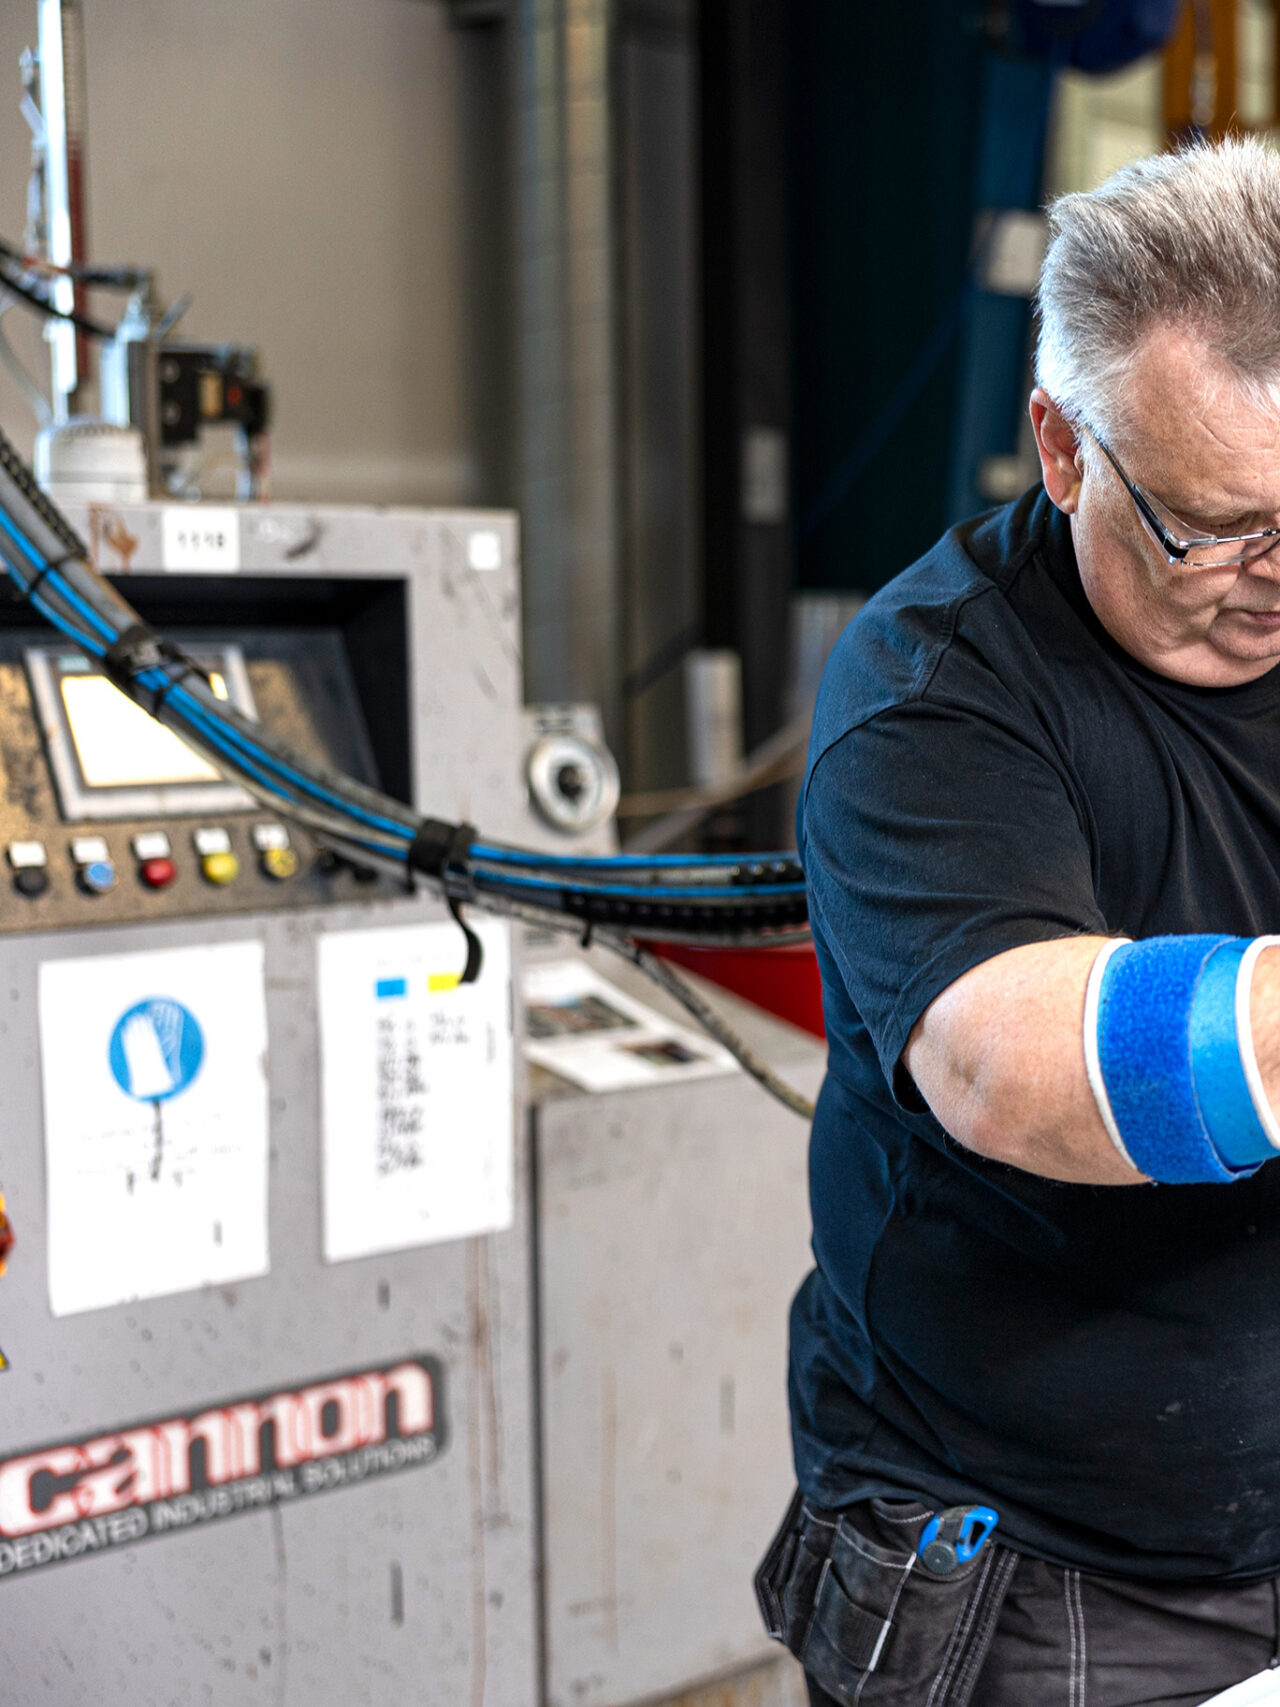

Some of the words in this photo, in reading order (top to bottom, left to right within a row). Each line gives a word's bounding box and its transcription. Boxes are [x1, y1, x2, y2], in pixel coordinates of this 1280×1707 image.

[0, 1361, 435, 1538] cannon
[0, 1507, 148, 1575] DEDICATED
[153, 1470, 295, 1531] INDUSTRIAL
[303, 1433, 437, 1492] SOLUTIONS
